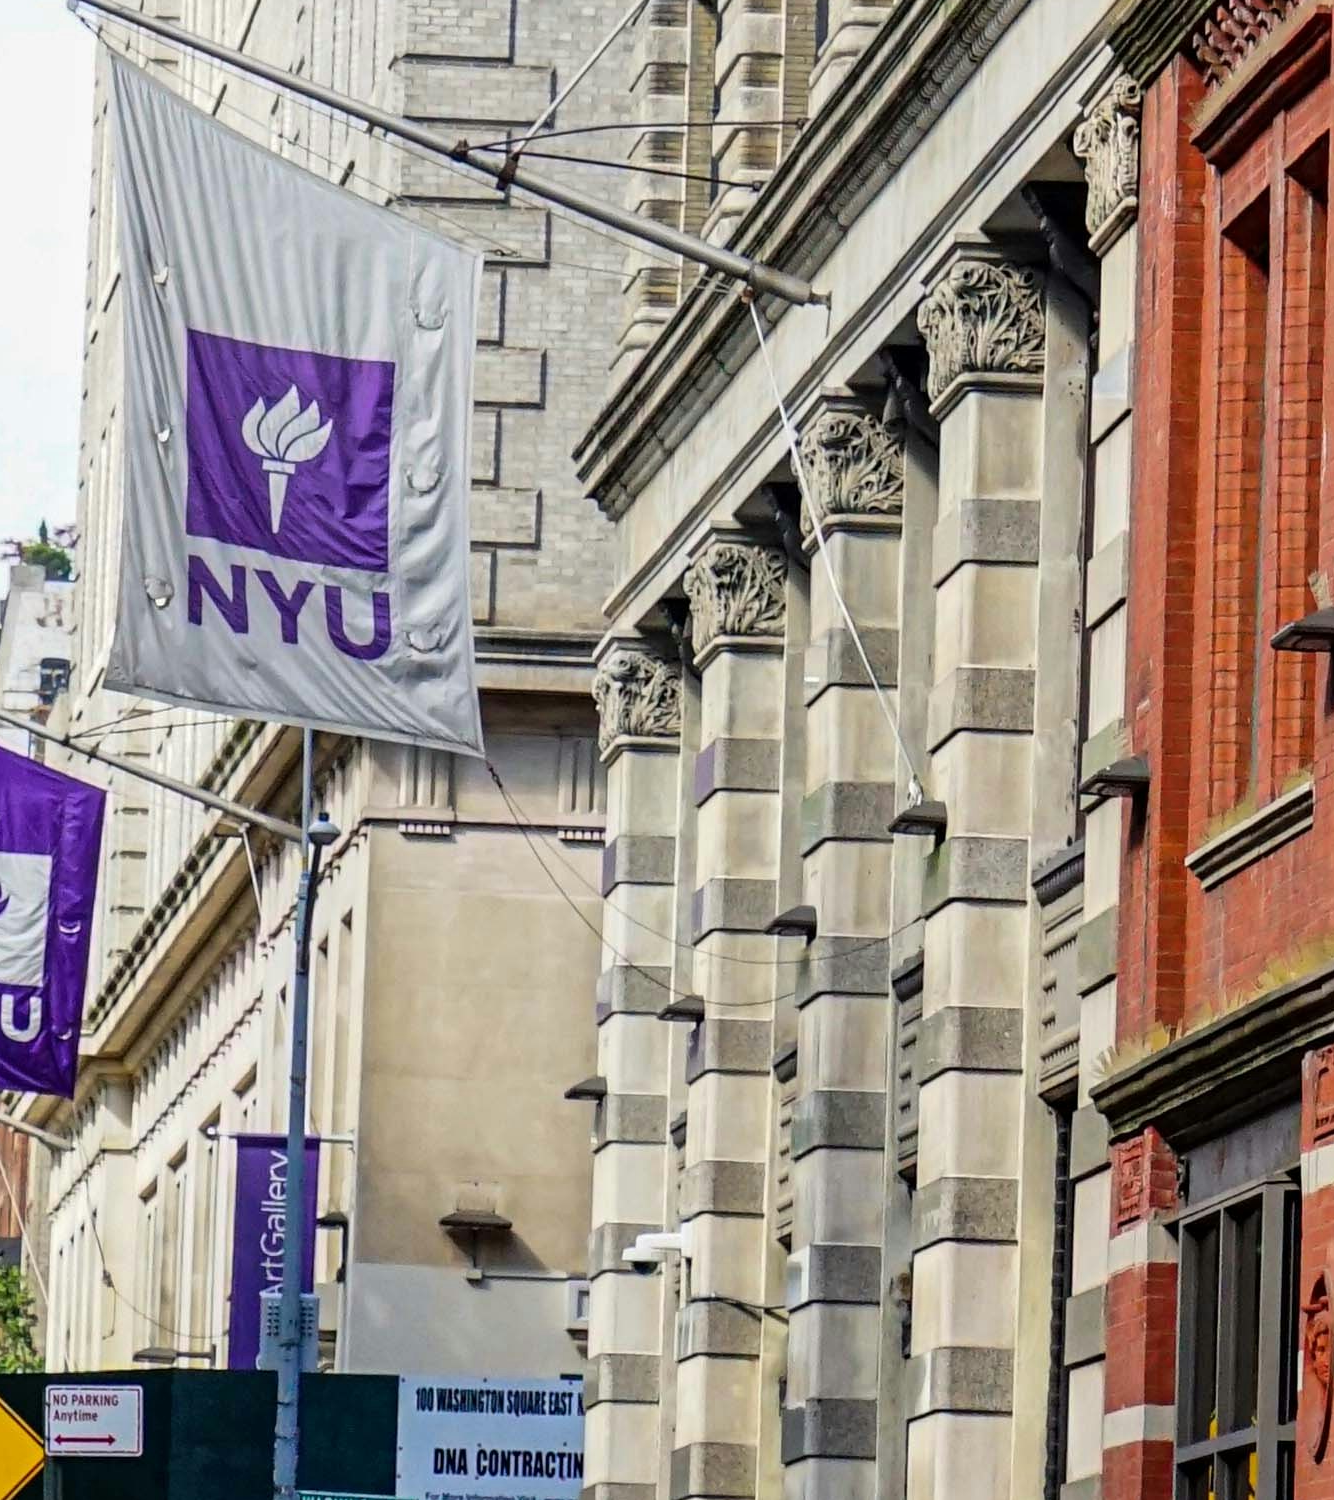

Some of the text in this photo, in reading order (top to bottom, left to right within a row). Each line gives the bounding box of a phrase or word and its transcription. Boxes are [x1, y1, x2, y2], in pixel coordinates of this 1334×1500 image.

[186, 553, 391, 664] NYU
[53, 1394, 119, 1407] NO PARKING
[416, 1387, 434, 1412] 100
[436, 1388, 505, 1415] WASHINGTON
[506, 1390, 546, 1418] SQUARE
[548, 1391, 572, 1417] EAST
[53, 1409, 98, 1424] Anytime
[433, 1448, 468, 1476] DNA
